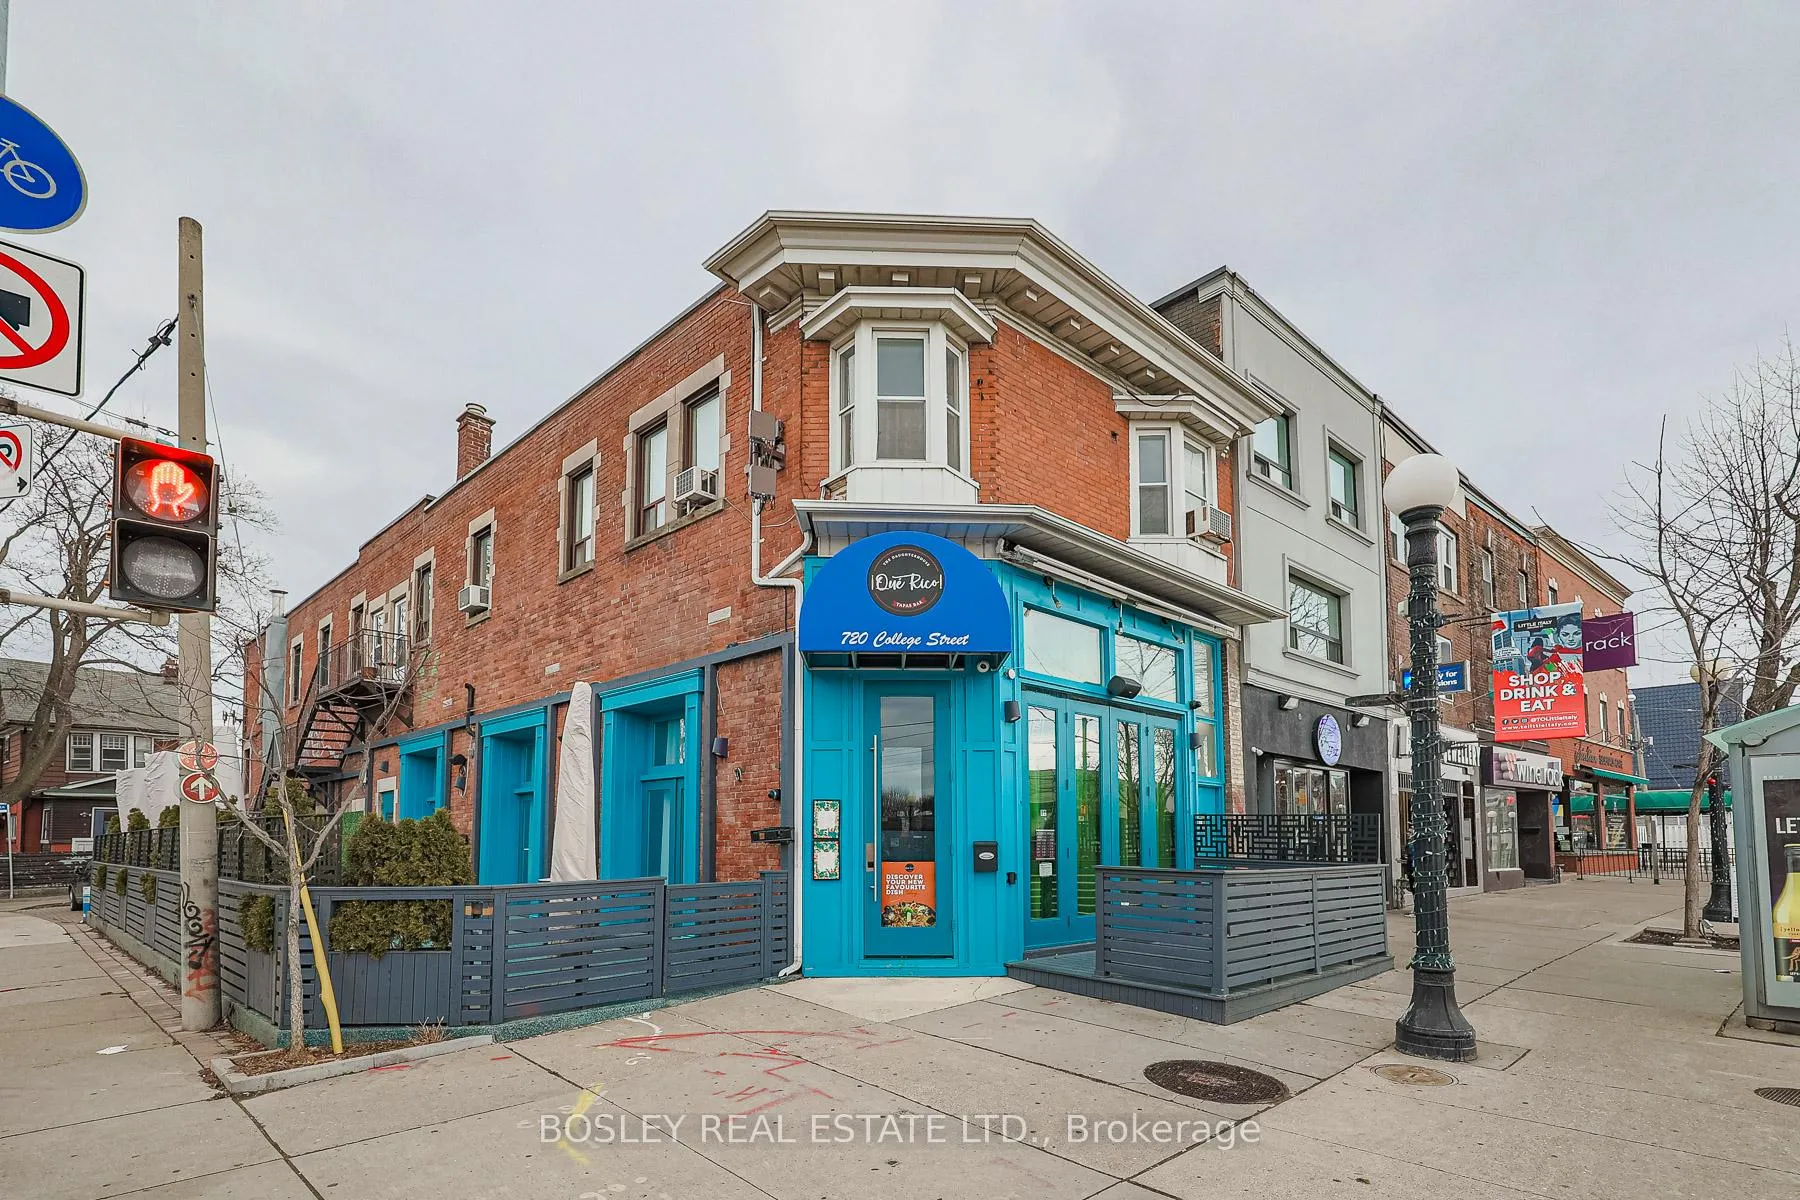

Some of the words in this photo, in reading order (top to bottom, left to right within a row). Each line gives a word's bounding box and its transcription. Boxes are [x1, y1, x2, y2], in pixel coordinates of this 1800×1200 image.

[908, 573, 940, 591] Rico
[1517, 621, 1537, 629] LITTLE
[1537, 619, 1553, 627] ITALY
[841, 631, 869, 645] 720
[873, 630, 922, 649] College
[926, 631, 970, 646] Street
[1585, 631, 1633, 652] rack
[1500, 685, 1559, 701] DRINK
[1561, 681, 1577, 696] &
[1520, 698, 1555, 712] EAT
[1775, 817, 1800, 834] LE
